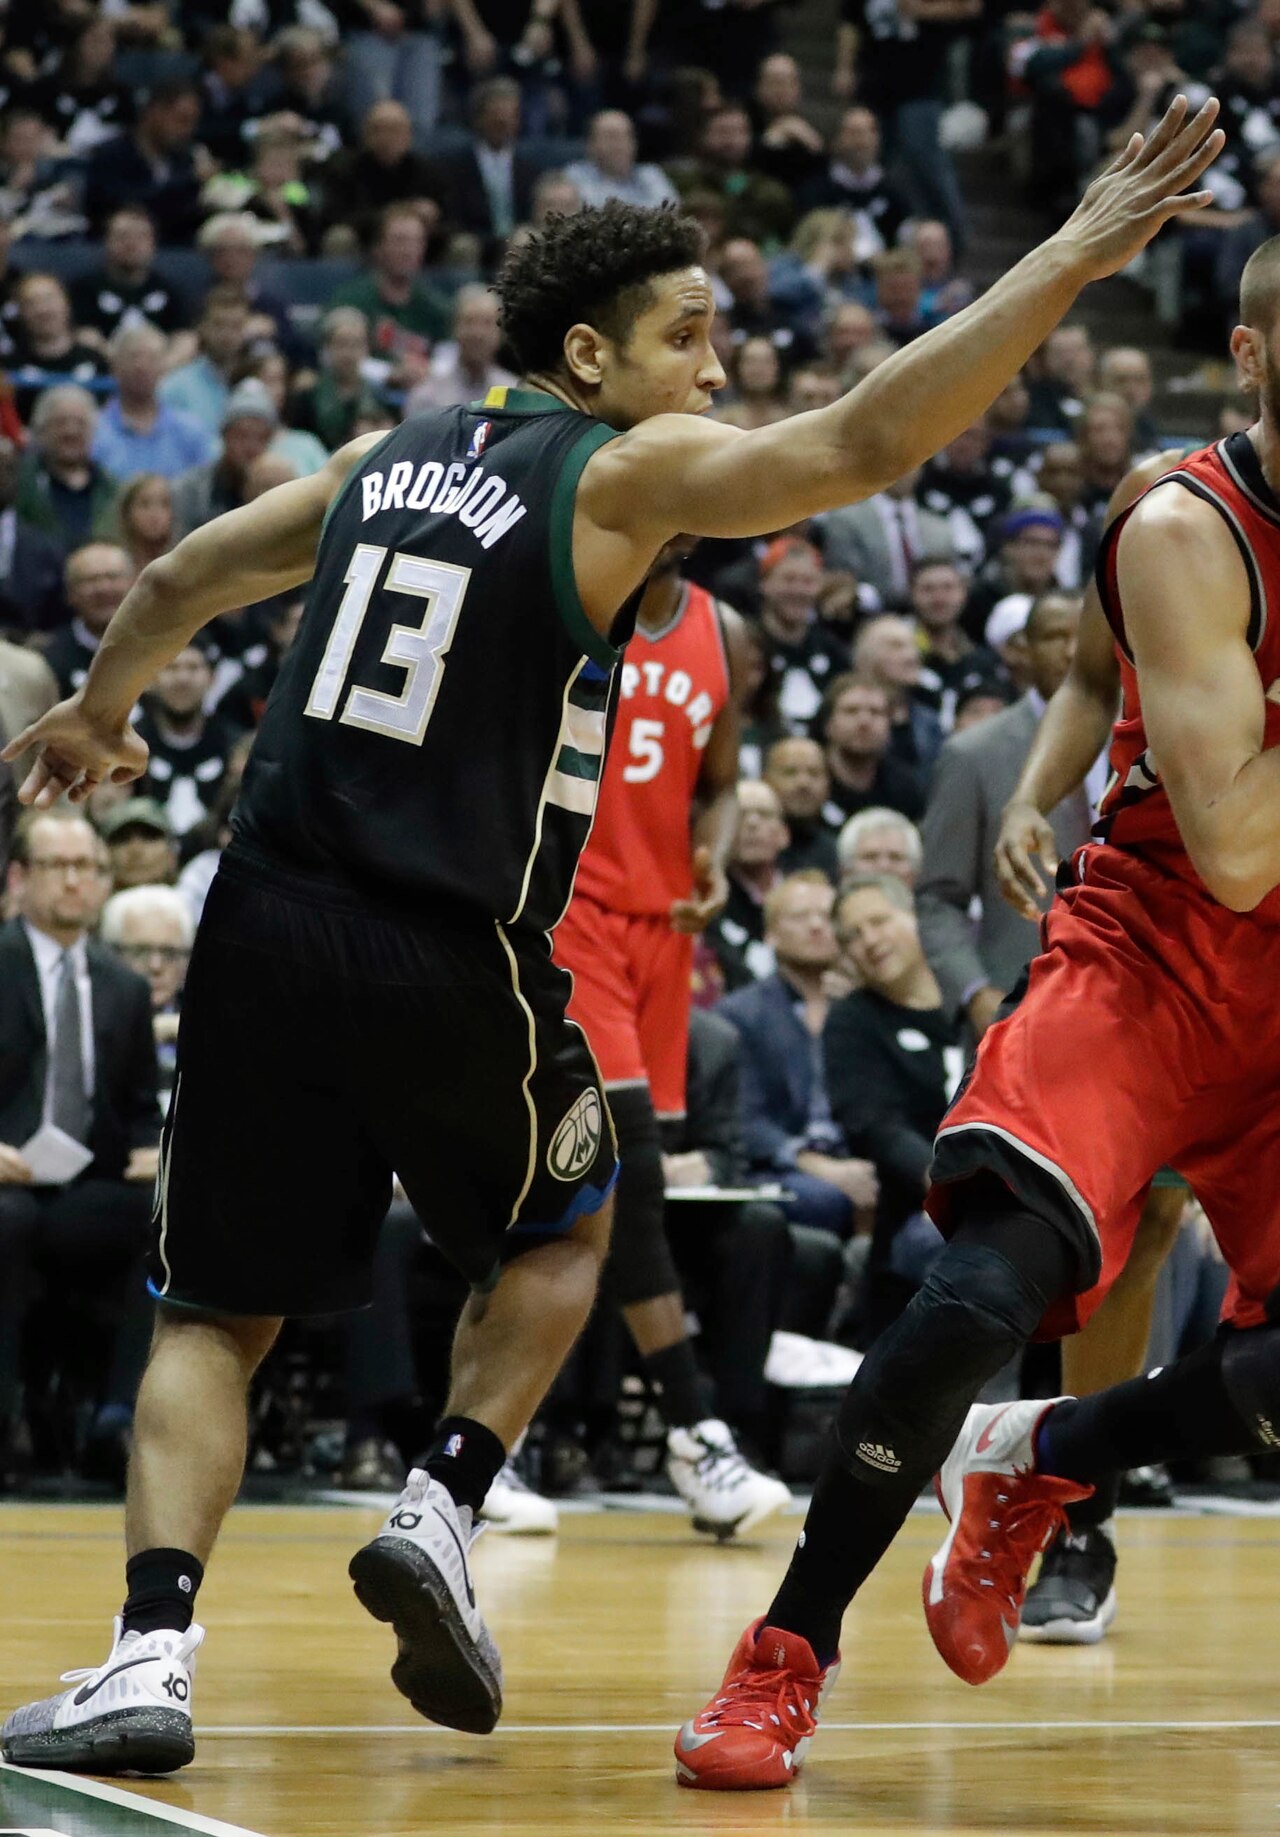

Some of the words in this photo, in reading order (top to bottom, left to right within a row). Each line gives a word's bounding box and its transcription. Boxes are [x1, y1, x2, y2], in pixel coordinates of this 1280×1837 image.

[361, 460, 527, 550] BROGDON
[303, 543, 473, 746] 13
[623, 717, 665, 783] 5
[858, 1442, 902, 1467] adidas
